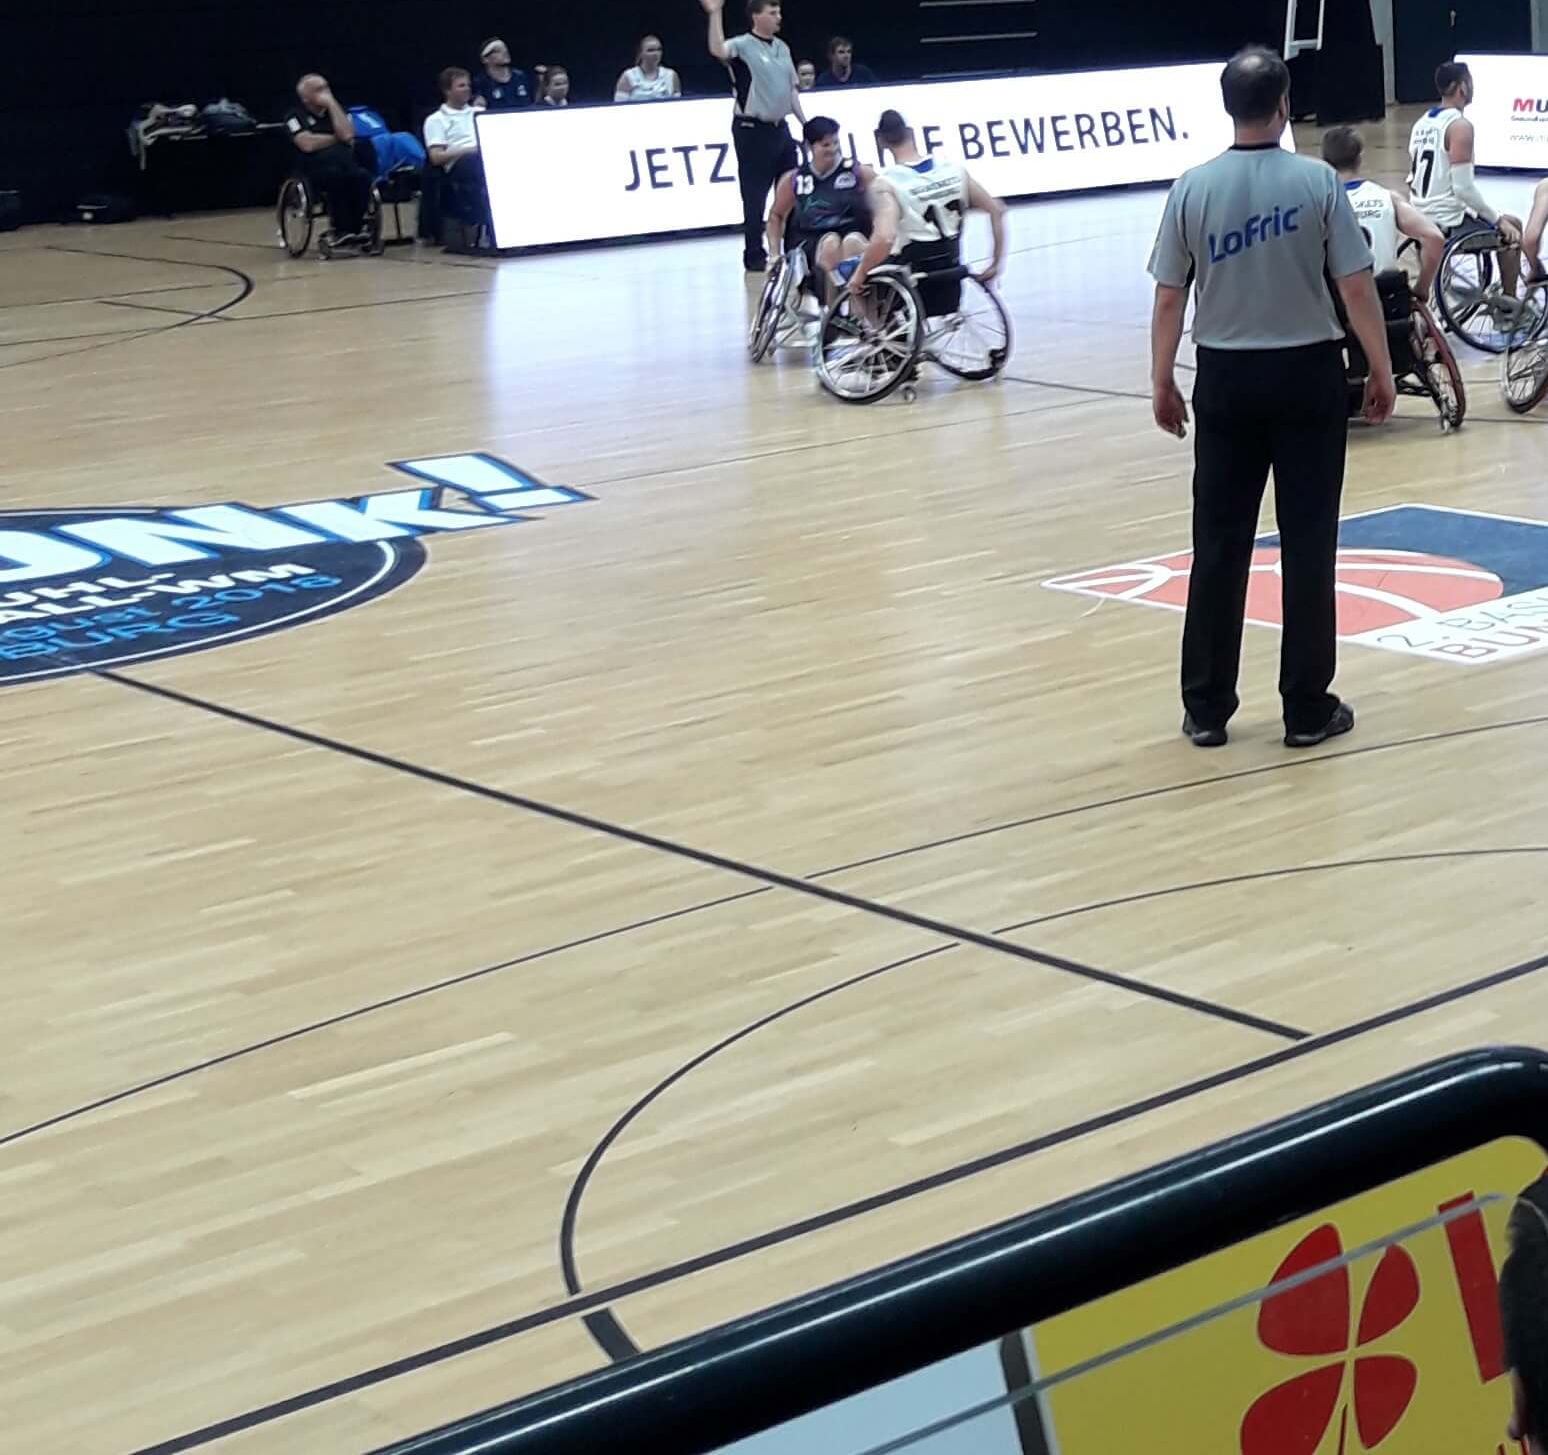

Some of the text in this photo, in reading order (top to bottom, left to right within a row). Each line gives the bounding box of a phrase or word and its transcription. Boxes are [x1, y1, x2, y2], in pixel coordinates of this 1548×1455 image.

[958, 106, 1189, 160] BEWERBEN.
[624, 142, 736, 192] JETZ
[796, 174, 815, 195] 13
[171, 574, 343, 611] 2018
